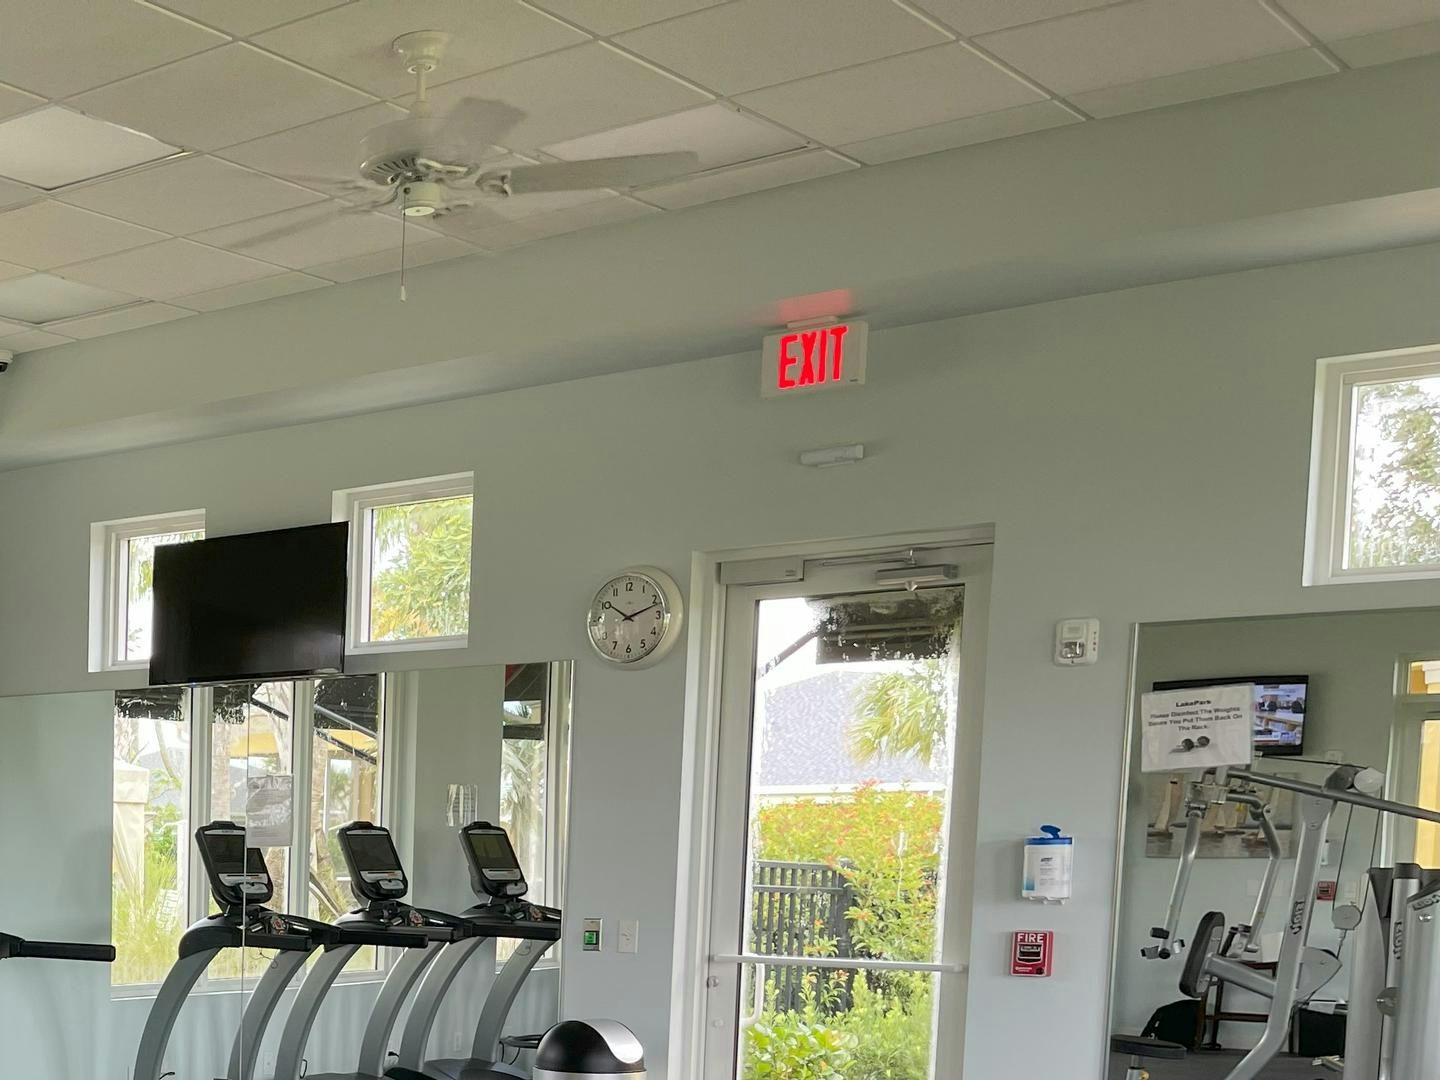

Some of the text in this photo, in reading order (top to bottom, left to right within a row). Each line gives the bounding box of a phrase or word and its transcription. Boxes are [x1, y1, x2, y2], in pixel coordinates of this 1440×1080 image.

[778, 325, 849, 390] EXIT
[625, 582, 633, 591] 12
[642, 585, 645, 593] 1
[612, 588, 618, 597] 11
[652, 595, 657, 604] 2
[601, 601, 611, 610] 10
[655, 610, 661, 620] 3
[650, 627, 656, 636] 4
[612, 641, 618, 650] 7
[640, 639, 646, 648] 5
[625, 644, 632, 653] 6
[1017, 933, 1045, 943] FIRE
